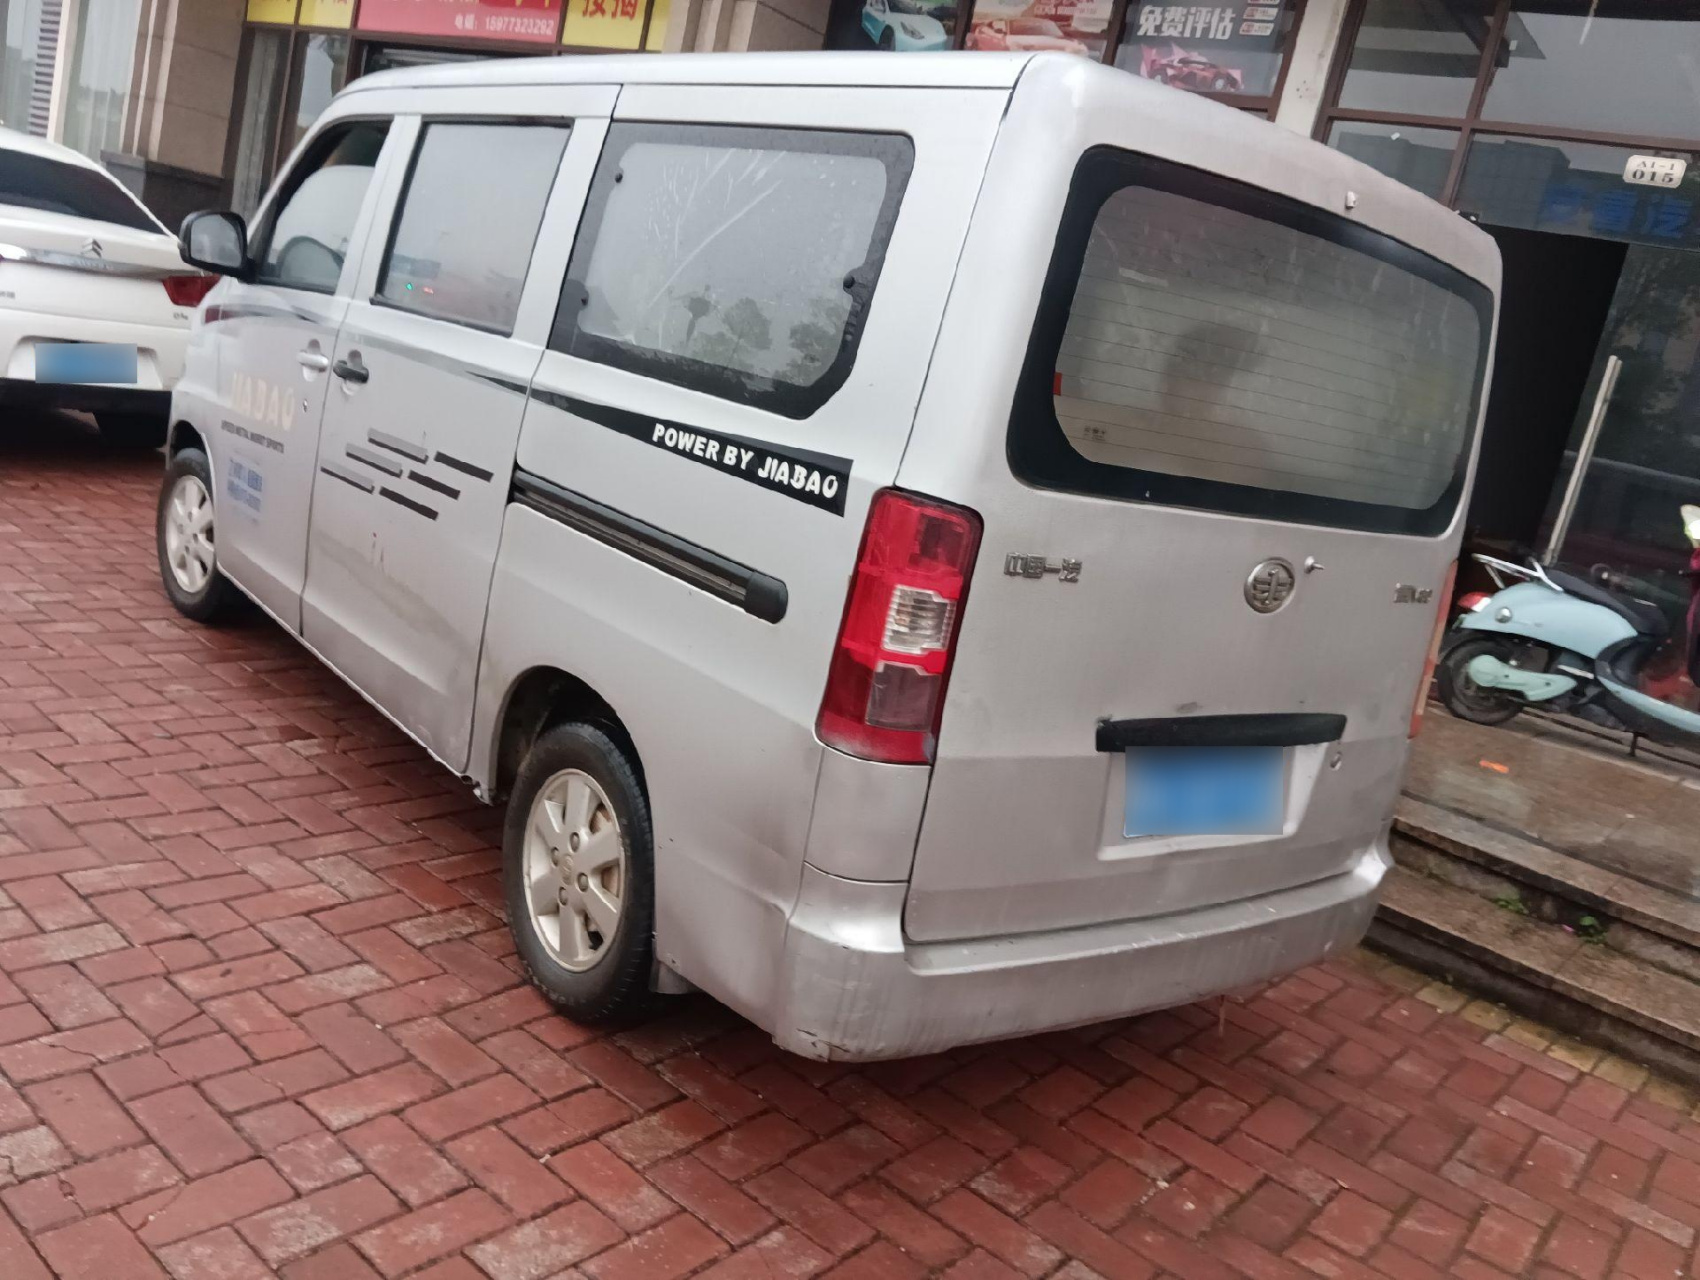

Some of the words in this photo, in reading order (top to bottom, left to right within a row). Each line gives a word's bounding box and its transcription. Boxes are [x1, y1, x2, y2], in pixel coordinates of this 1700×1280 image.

[1137, 4, 1236, 40] 免费评估
[1632, 169, 1674, 183] 015
[652, 423, 720, 463] POWER
[723, 445, 754, 470] BY
[757, 457, 839, 499] JIABAO
[1003, 552, 1082, 583] 中国一汽
